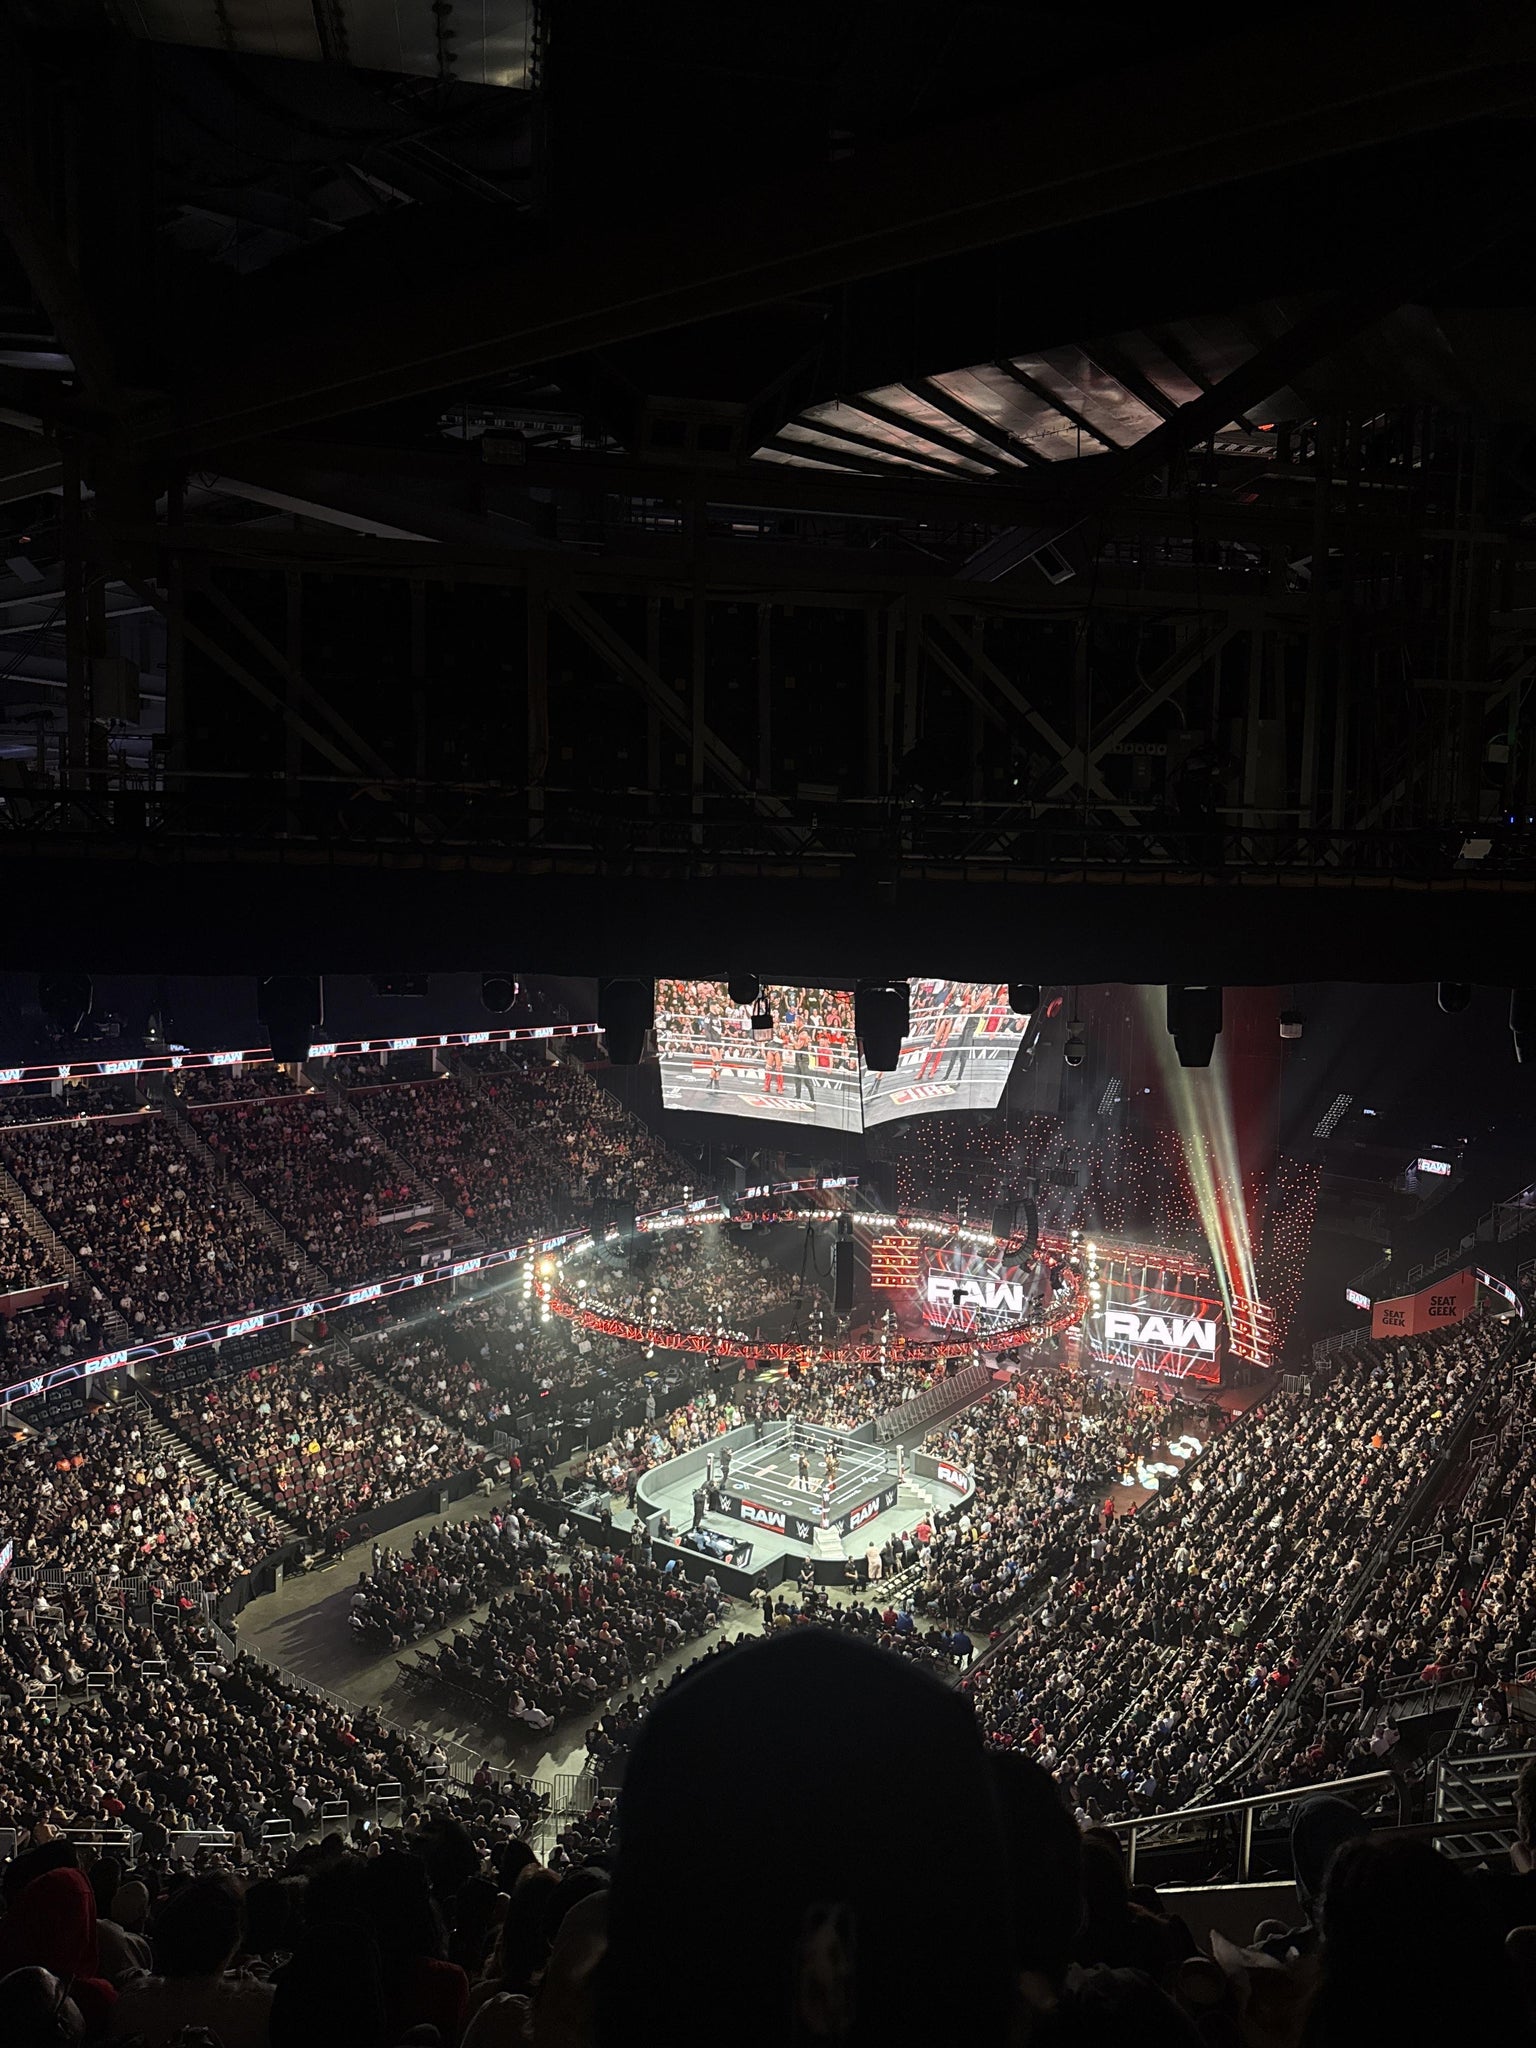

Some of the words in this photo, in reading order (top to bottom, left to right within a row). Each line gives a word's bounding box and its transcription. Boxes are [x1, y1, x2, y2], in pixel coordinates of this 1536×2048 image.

[105, 1060, 139, 1074] RAW
[1422, 1160, 1447, 1174] RAW
[453, 1258, 481, 1276] RAW
[349, 1284, 381, 1304] RAW
[928, 1276, 1023, 1311] RAW
[1430, 1295, 1457, 1306] SEAT
[1383, 1309, 1406, 1318] SEAT
[1428, 1306, 1457, 1317] GEEK
[227, 1315, 264, 1337] RAW
[1105, 1312, 1216, 1350] RAW
[1382, 1317, 1406, 1328] GEEK
[85, 1351, 128, 1375] RAW
[937, 1467, 968, 1489] RAW
[741, 1505, 786, 1528] RAW
[850, 1497, 880, 1530] RAW
